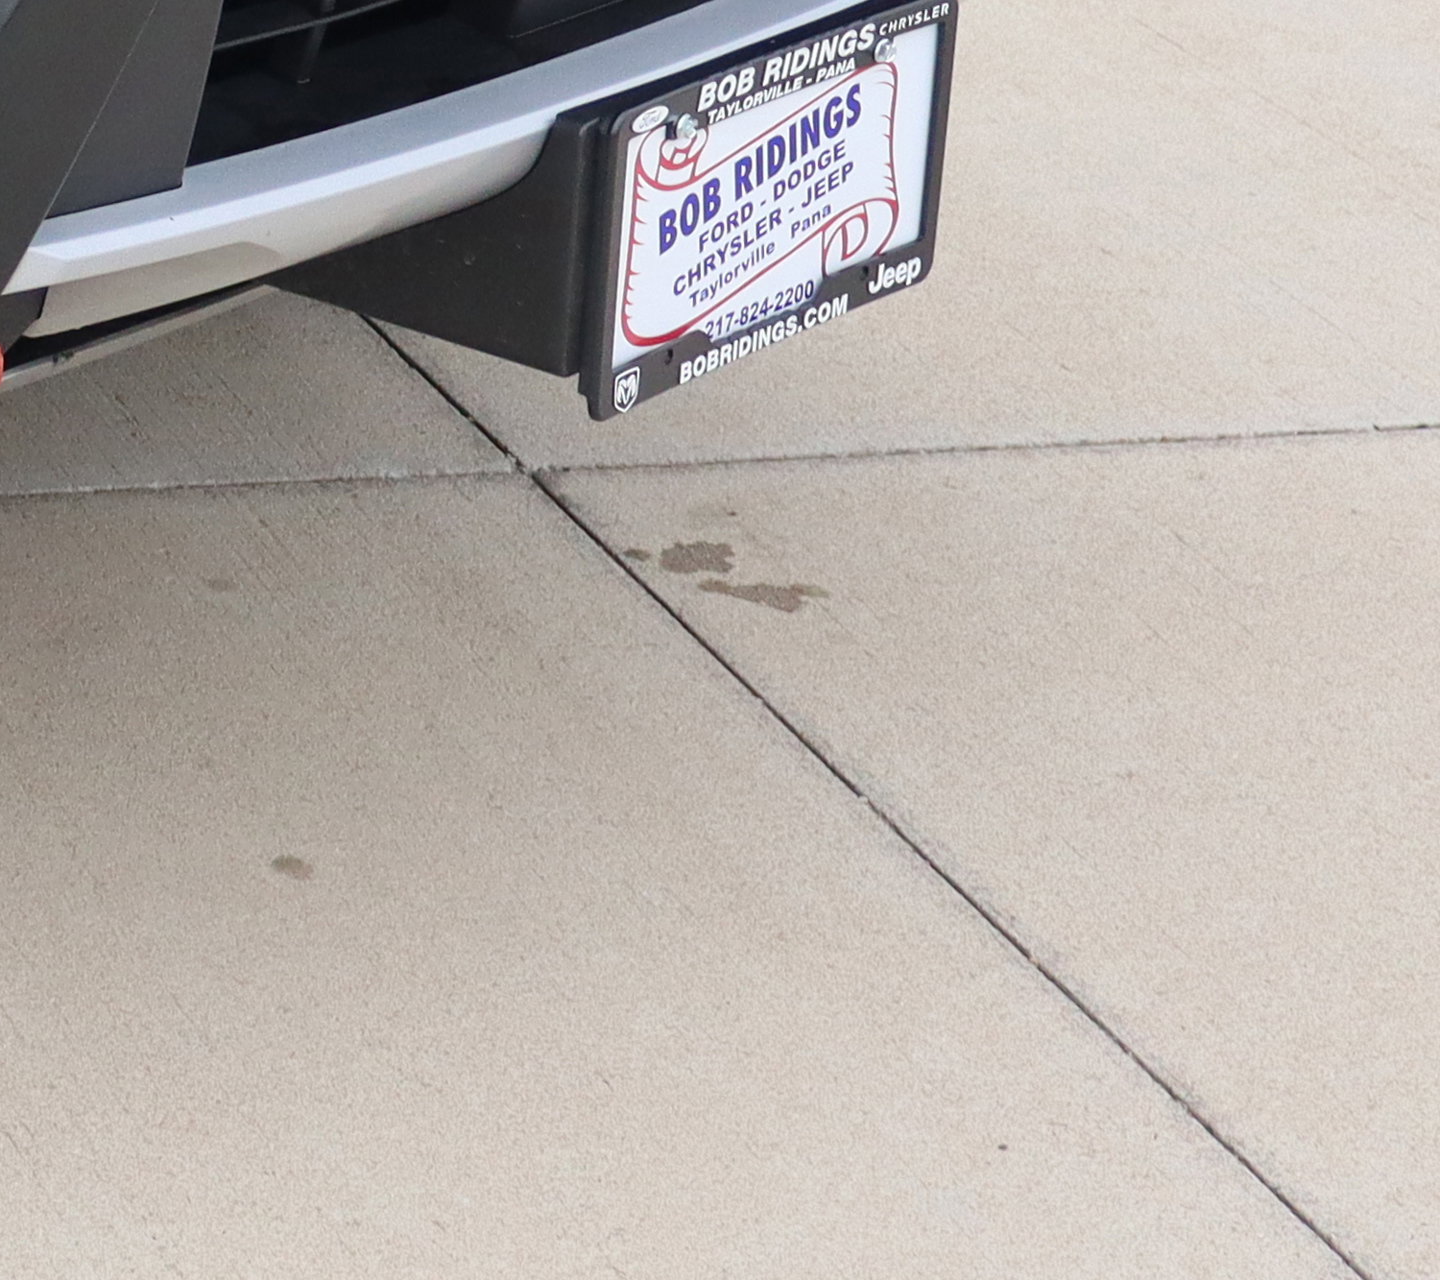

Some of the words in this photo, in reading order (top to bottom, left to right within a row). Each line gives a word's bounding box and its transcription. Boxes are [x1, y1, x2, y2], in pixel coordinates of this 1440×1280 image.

[879, 2, 950, 36] CHRYSLER
[698, 68, 756, 113] BOB
[762, 22, 877, 88] RIDINGS
[707, 75, 803, 125] TAYLORVILLE
[815, 57, 857, 84] PANA
[658, 177, 722, 256] BOB
[734, 83, 863, 202] RIDINGS
[698, 201, 754, 254] FORD
[773, 139, 847, 202] DODGE
[672, 208, 782, 296] CHRYSLER
[801, 161, 854, 209] JEEP
[688, 240, 776, 308] Taylorville
[791, 204, 832, 239] Pana
[705, 279, 815, 339] 217-824-2200
[868, 256, 922, 295] Jeep
[680, 293, 849, 385] BOBRIDINGS.COM
